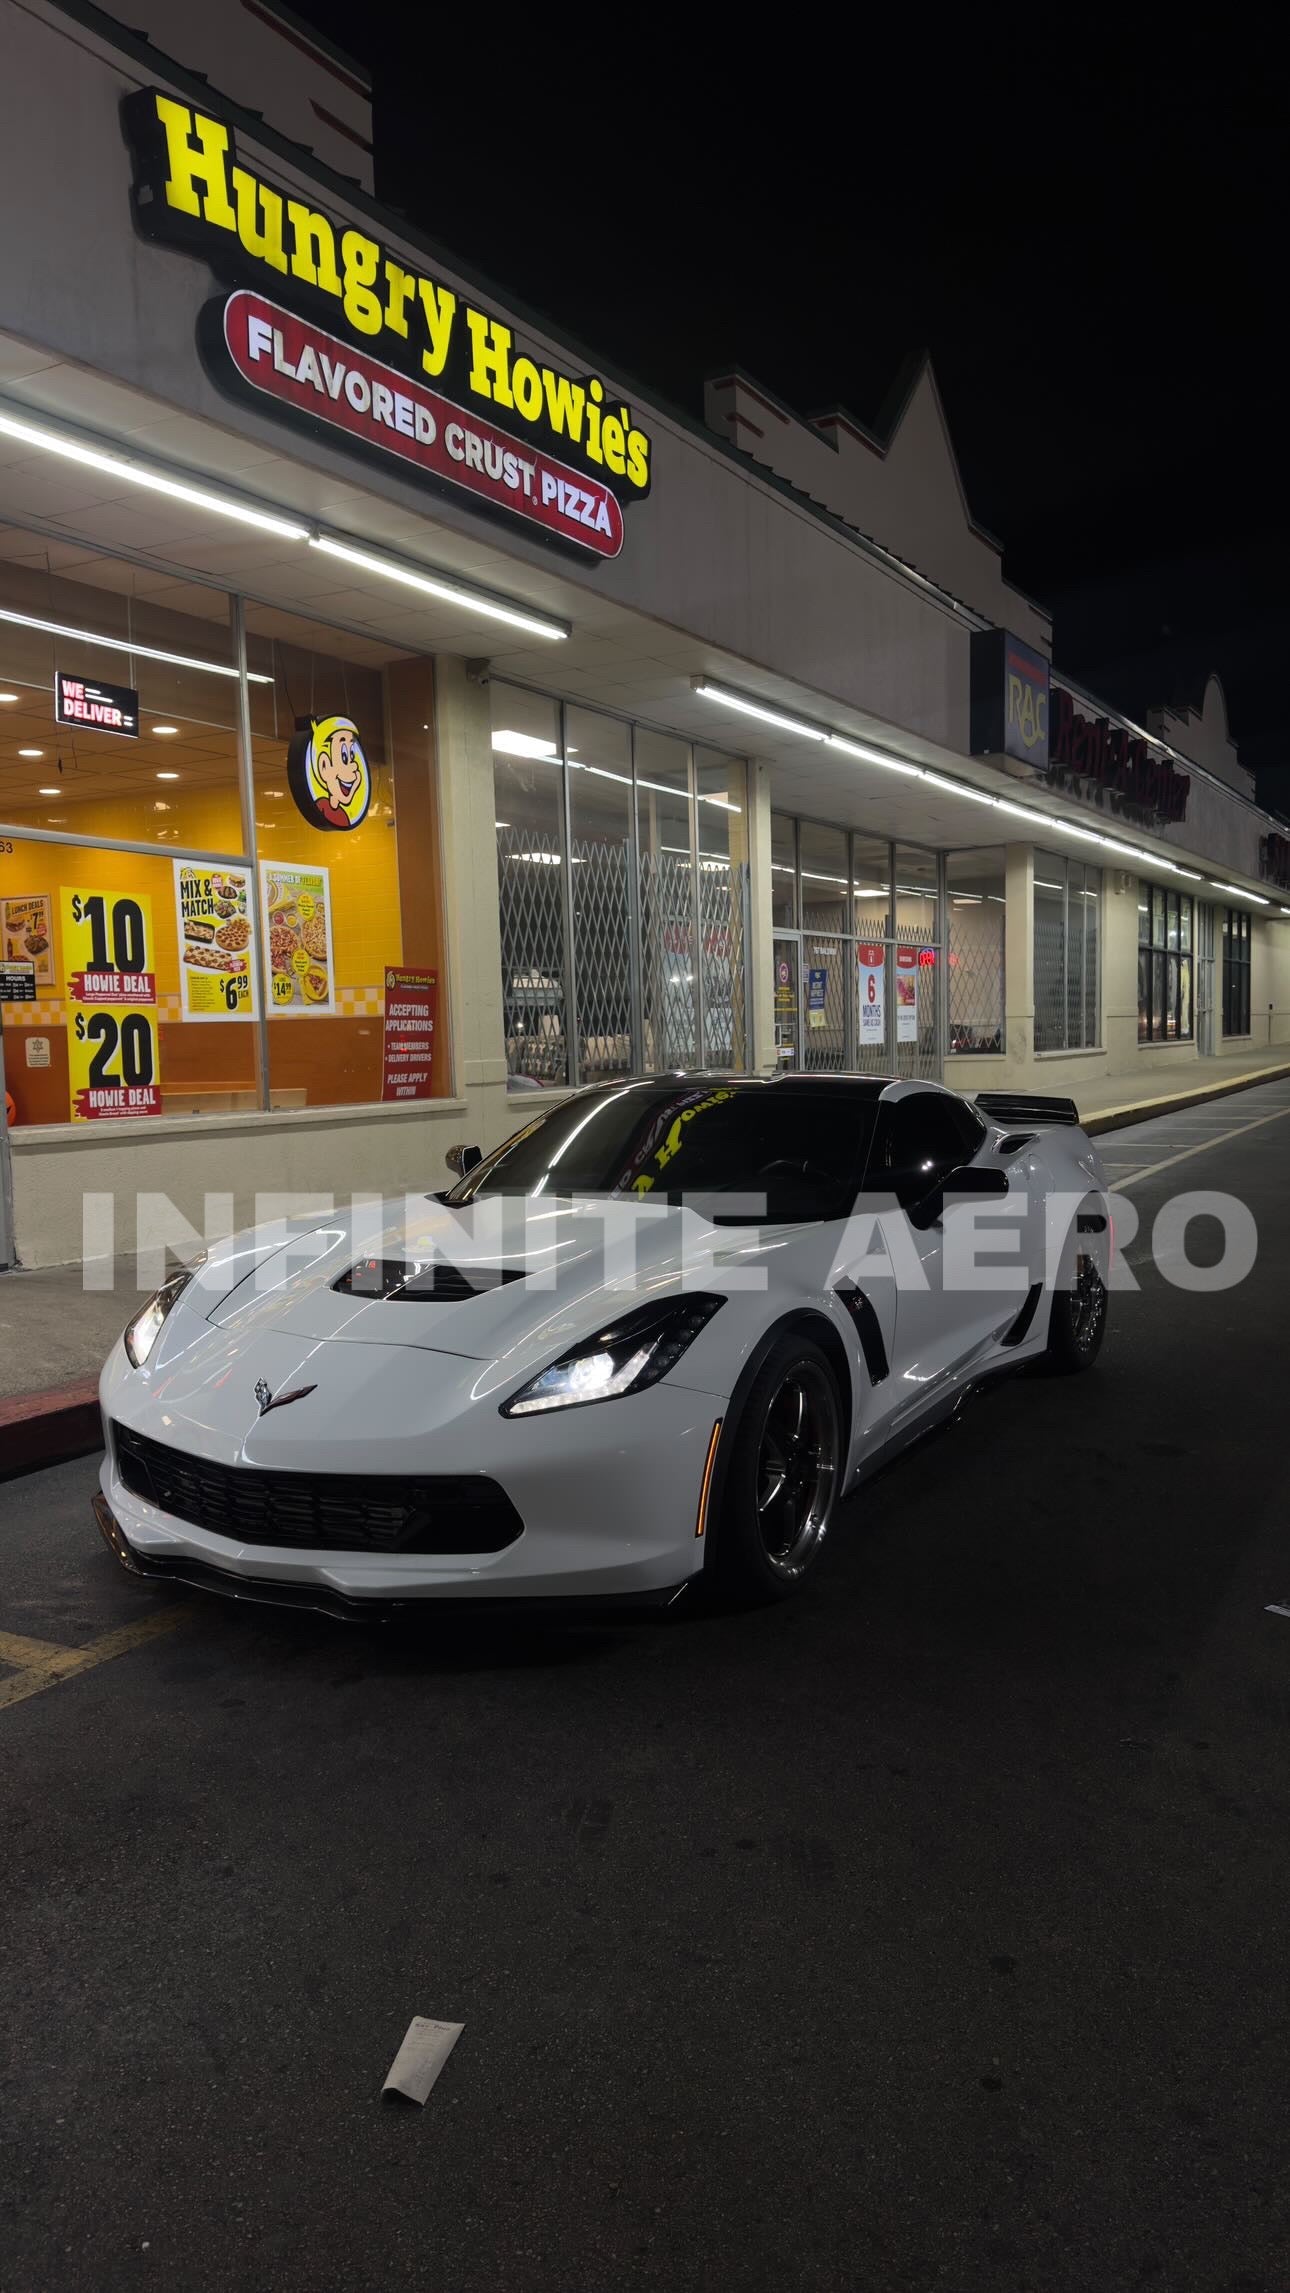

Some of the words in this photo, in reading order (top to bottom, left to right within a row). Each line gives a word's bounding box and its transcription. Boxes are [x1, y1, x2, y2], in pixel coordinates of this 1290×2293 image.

[156, 95, 456, 376] Hungry
[466, 308, 649, 488] Howie's
[248, 315, 437, 446] FLAVORED
[541, 470, 613, 539] PIZZA
[62, 680, 84, 700] WE
[63, 697, 122, 727] DELIVER
[1007, 673, 1046, 748] RAC
[180, 879, 201, 900] MIX
[204, 878, 213, 897] &
[11, 902, 28, 915] LUNCH
[28, 899, 44, 910] DEALS
[181, 898, 214, 918] MATCH
[72, 894, 146, 973] $10
[919, 950, 935, 966] OPEN
[84, 974, 121, 992] HOWIE
[123, 975, 151, 993] DEAL
[867, 973, 876, 1003] 6
[389, 1003, 429, 1017] ACCEPTING
[862, 1004, 881, 1018] MONTHS
[385, 1020, 433, 1032] APPLICATIONS
[75, 1012, 153, 1088] $20
[388, 1054, 409, 1063] DELIVERY
[410, 1053, 432, 1062] DRIVERS
[387, 1073, 408, 1084] PLEASE
[408, 1072, 428, 1083] APPLY
[89, 1089, 126, 1108] HOWIE
[128, 1088, 156, 1106] DEAL
[396, 1086, 417, 1097] WITHIN
